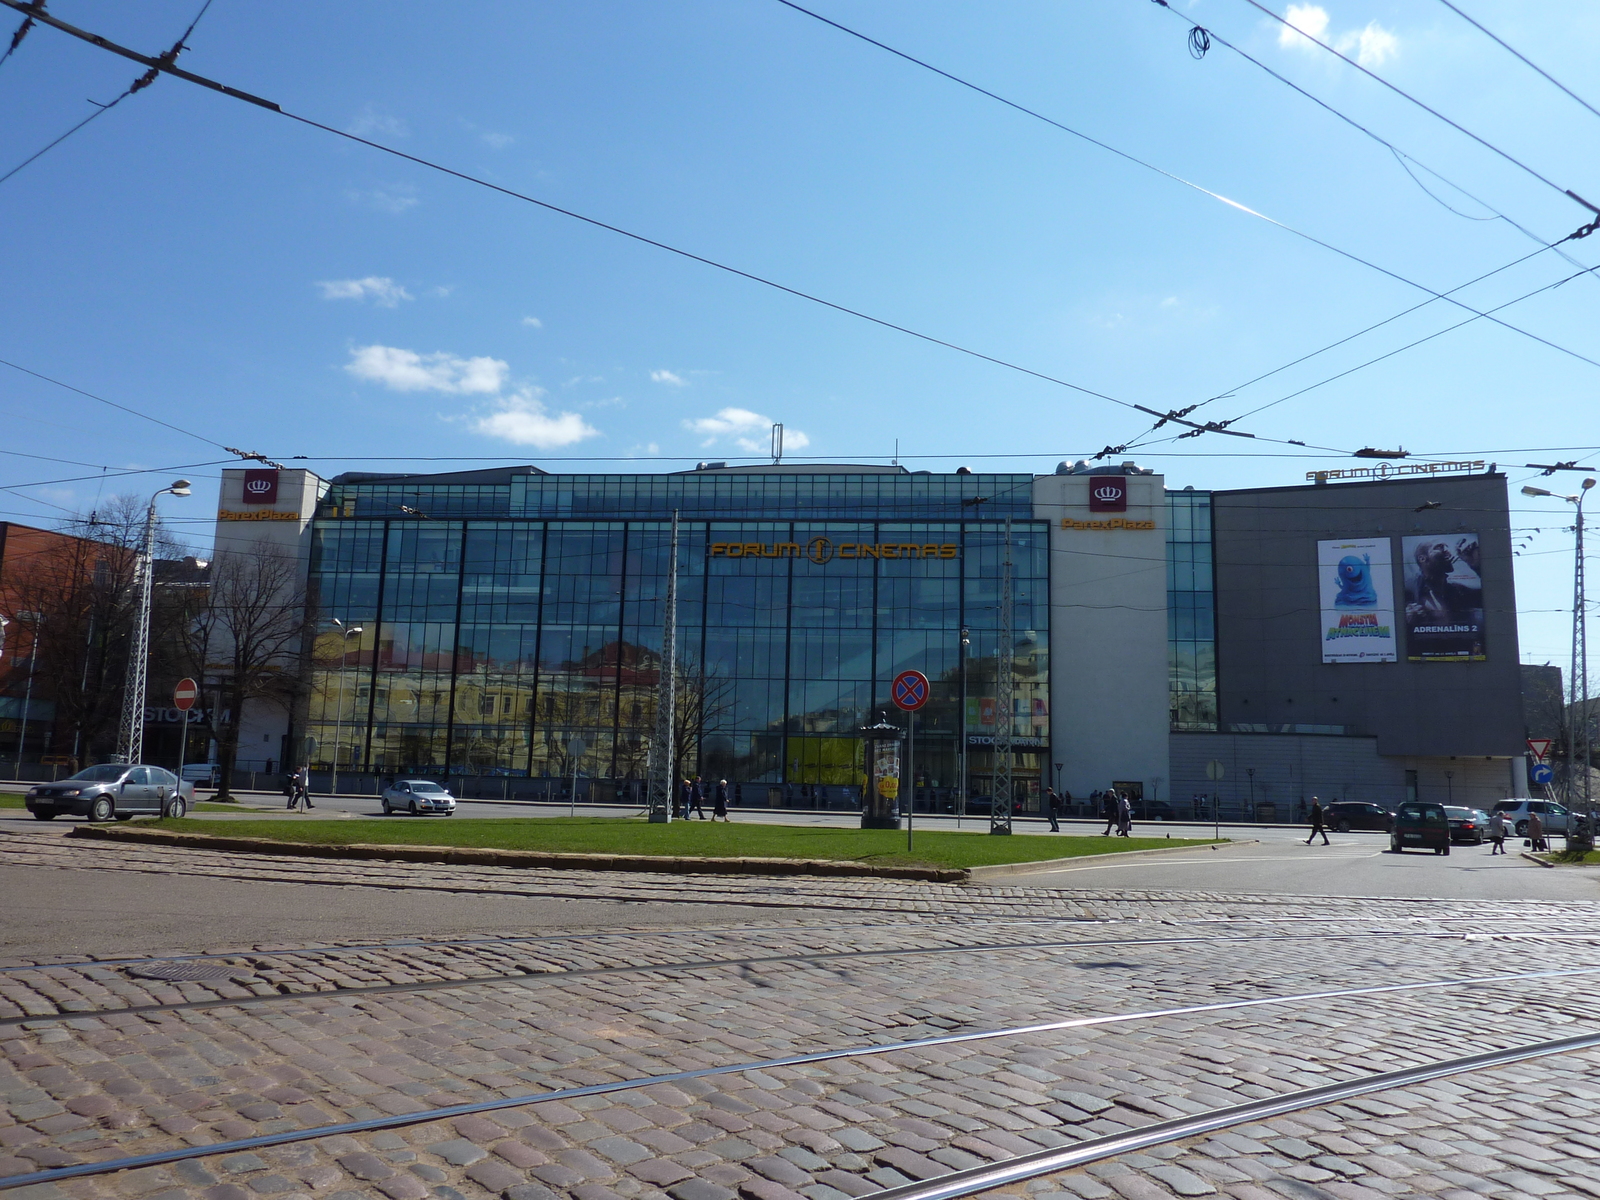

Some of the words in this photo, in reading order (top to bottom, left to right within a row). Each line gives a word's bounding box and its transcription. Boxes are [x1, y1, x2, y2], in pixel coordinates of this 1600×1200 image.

[1306, 467, 1370, 481] FORUM
[1399, 460, 1485, 475] CINEMAS
[219, 508, 299, 520] ParexPlaza
[1061, 517, 1155, 530] ParexPlaza
[711, 542, 800, 557] FORUM
[838, 543, 957, 559] CINEMAS
